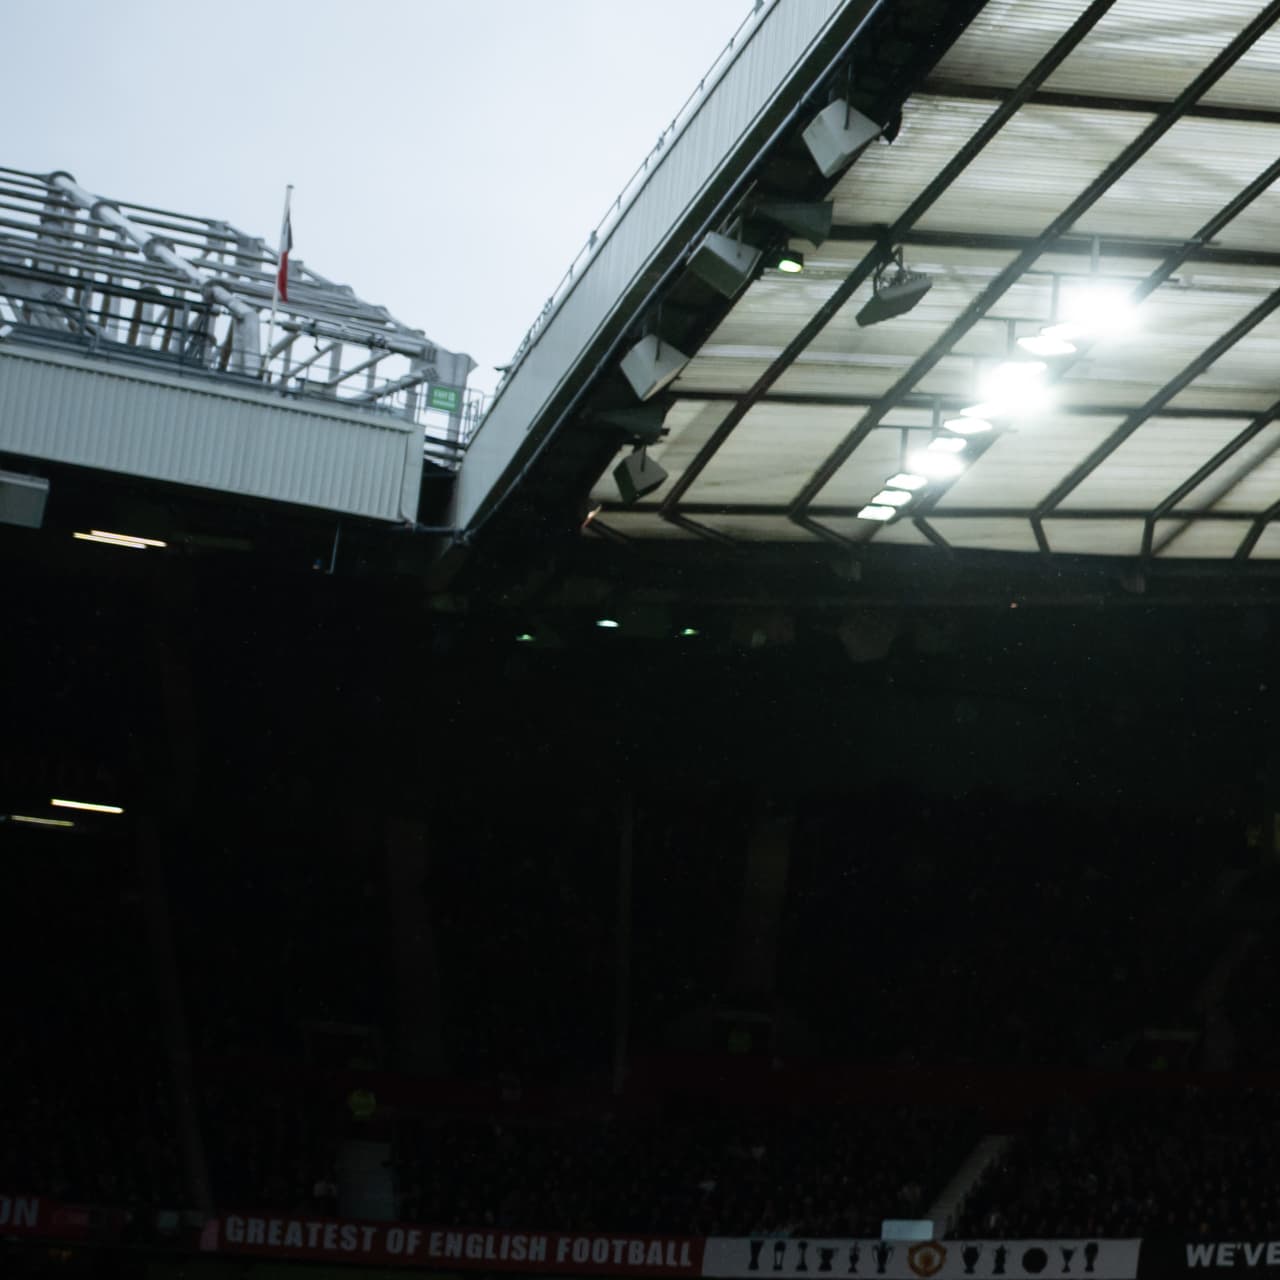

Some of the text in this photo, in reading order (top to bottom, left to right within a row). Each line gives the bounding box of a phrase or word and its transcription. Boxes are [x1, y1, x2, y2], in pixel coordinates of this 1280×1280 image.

[225, 1213, 693, 1269] GREATEST OF ENGLISH FOOTBALL
